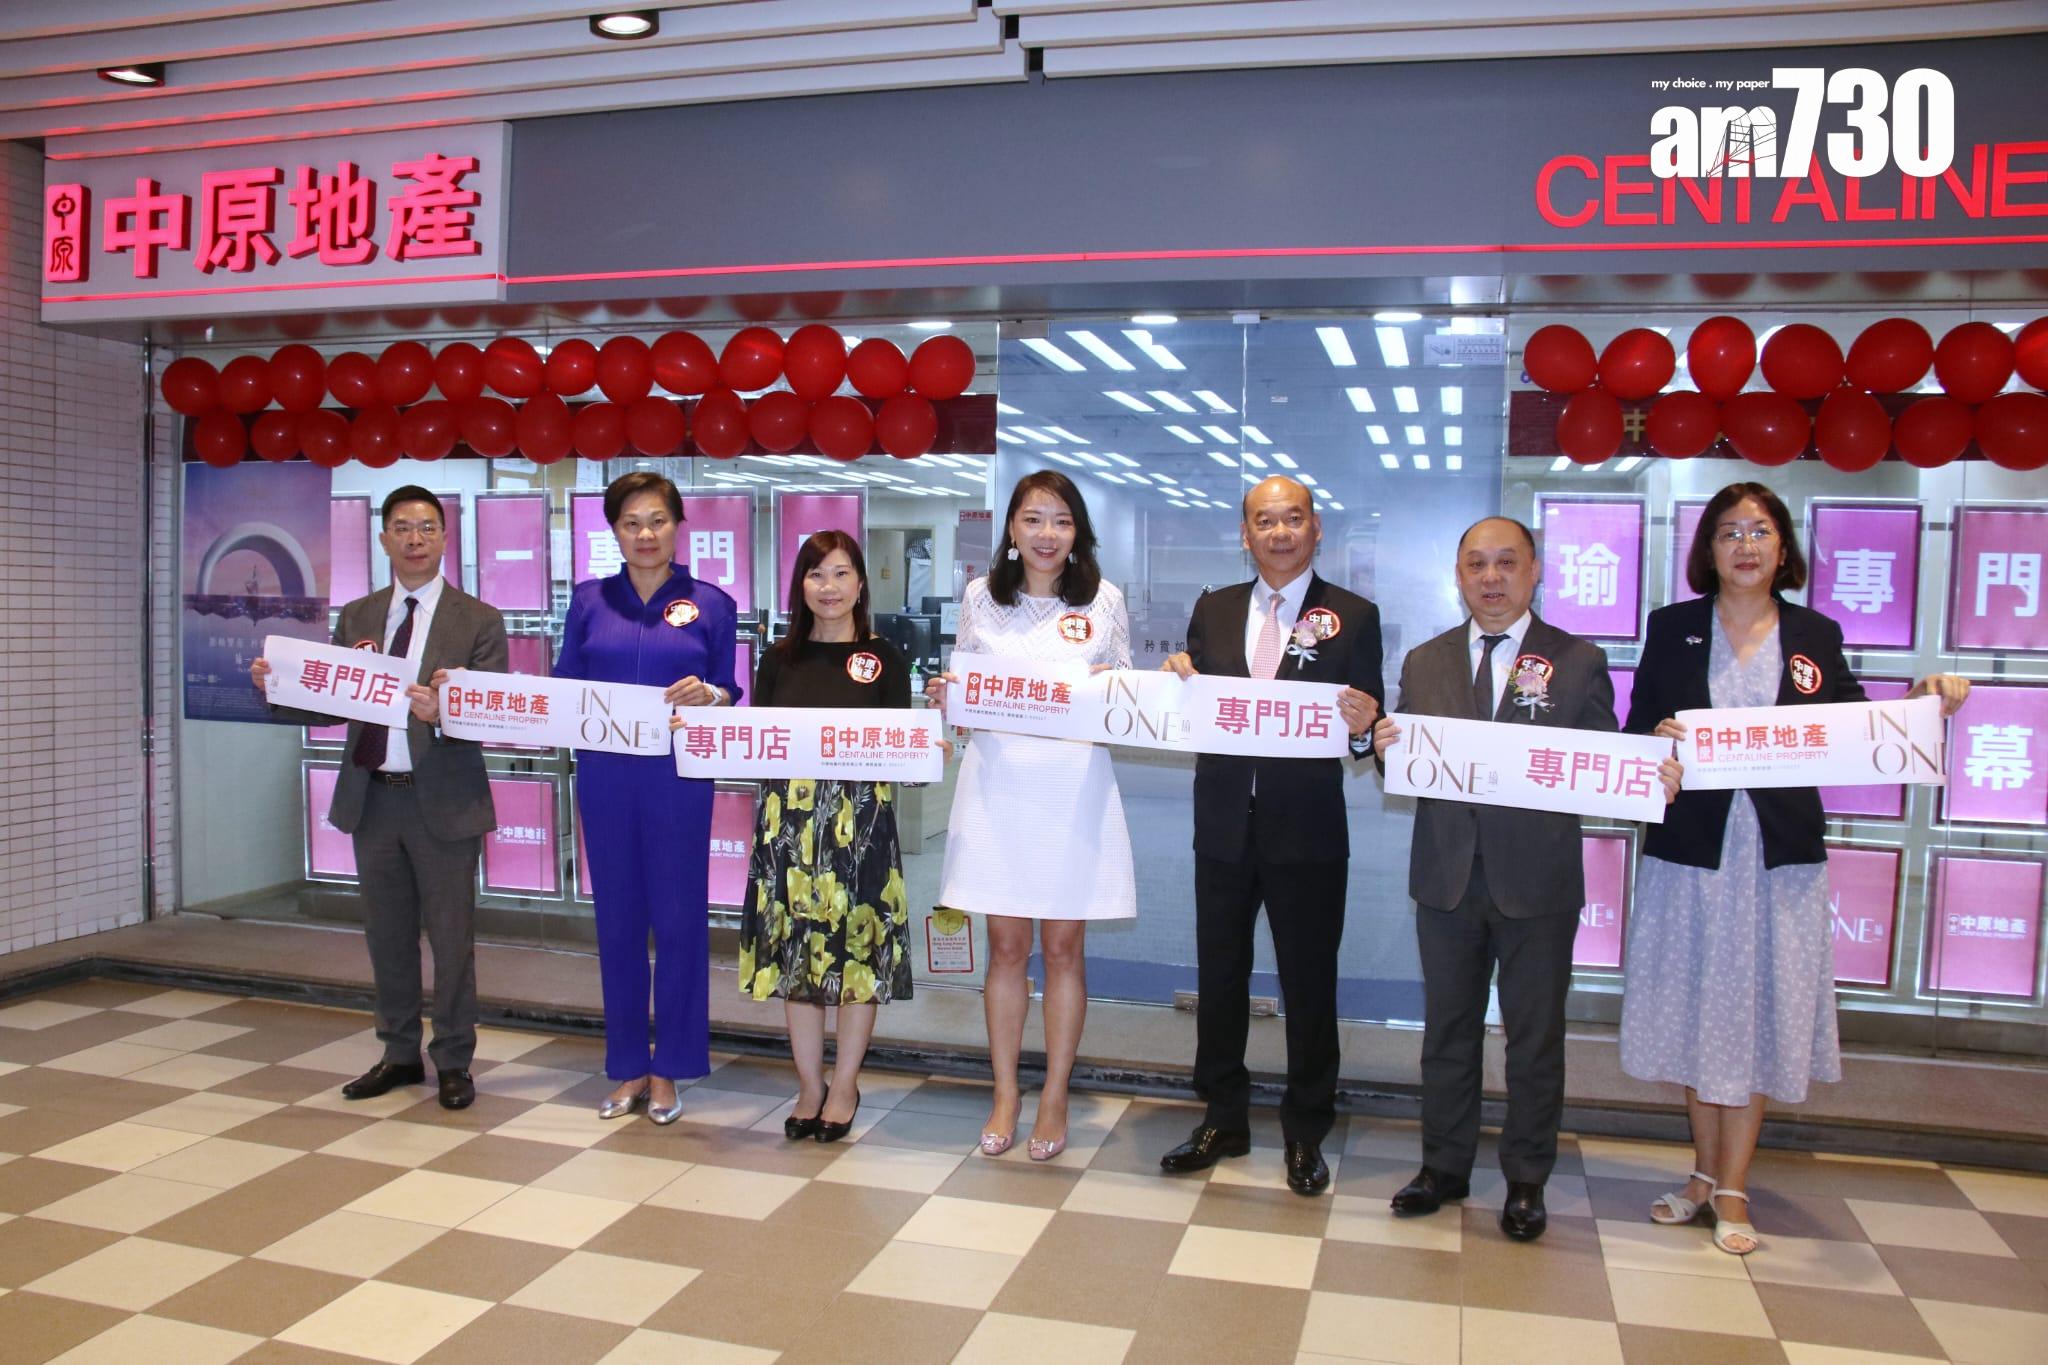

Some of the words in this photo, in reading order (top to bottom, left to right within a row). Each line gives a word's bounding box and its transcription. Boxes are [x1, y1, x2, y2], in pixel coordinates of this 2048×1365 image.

[103, 153, 482, 279] 中原地產
[690, 531, 734, 585] 門
[1558, 542, 1621, 607] 瑜
[1832, 548, 1896, 614] 專
[1976, 552, 2040, 618] 門
[299, 659, 400, 706] 專門店
[983, 674, 1072, 704] 中原地產
[1106, 676, 1140, 707] IN
[464, 689, 549, 715] 中原地產
[464, 711, 506, 722] CENTALINE
[508, 714, 549, 725] PROPERTY
[581, 687, 611, 717] IN
[982, 699, 1026, 712] CENTALINE
[1028, 703, 1070, 715] PROPERTY
[1215, 697, 1333, 738] 專門店
[580, 717, 649, 748] ONE
[838, 727, 929, 749] 中原地產
[1104, 706, 1180, 742] ONE
[1408, 722, 1444, 757] IN
[1717, 723, 1829, 750] 中原地產
[1868, 709, 1908, 741] IN
[685, 724, 791, 760] 專門店
[839, 750, 884, 759] CENTALINE
[886, 751, 929, 760] PROPERTY
[1718, 752, 1773, 763] CENTALINE
[1776, 750, 1829, 761] PROPERTY
[1965, 723, 2033, 791] 幕
[1406, 757, 1488, 795] ONE
[1525, 747, 1657, 799] 專門店
[1960, 915, 2027, 934] 中原地產
